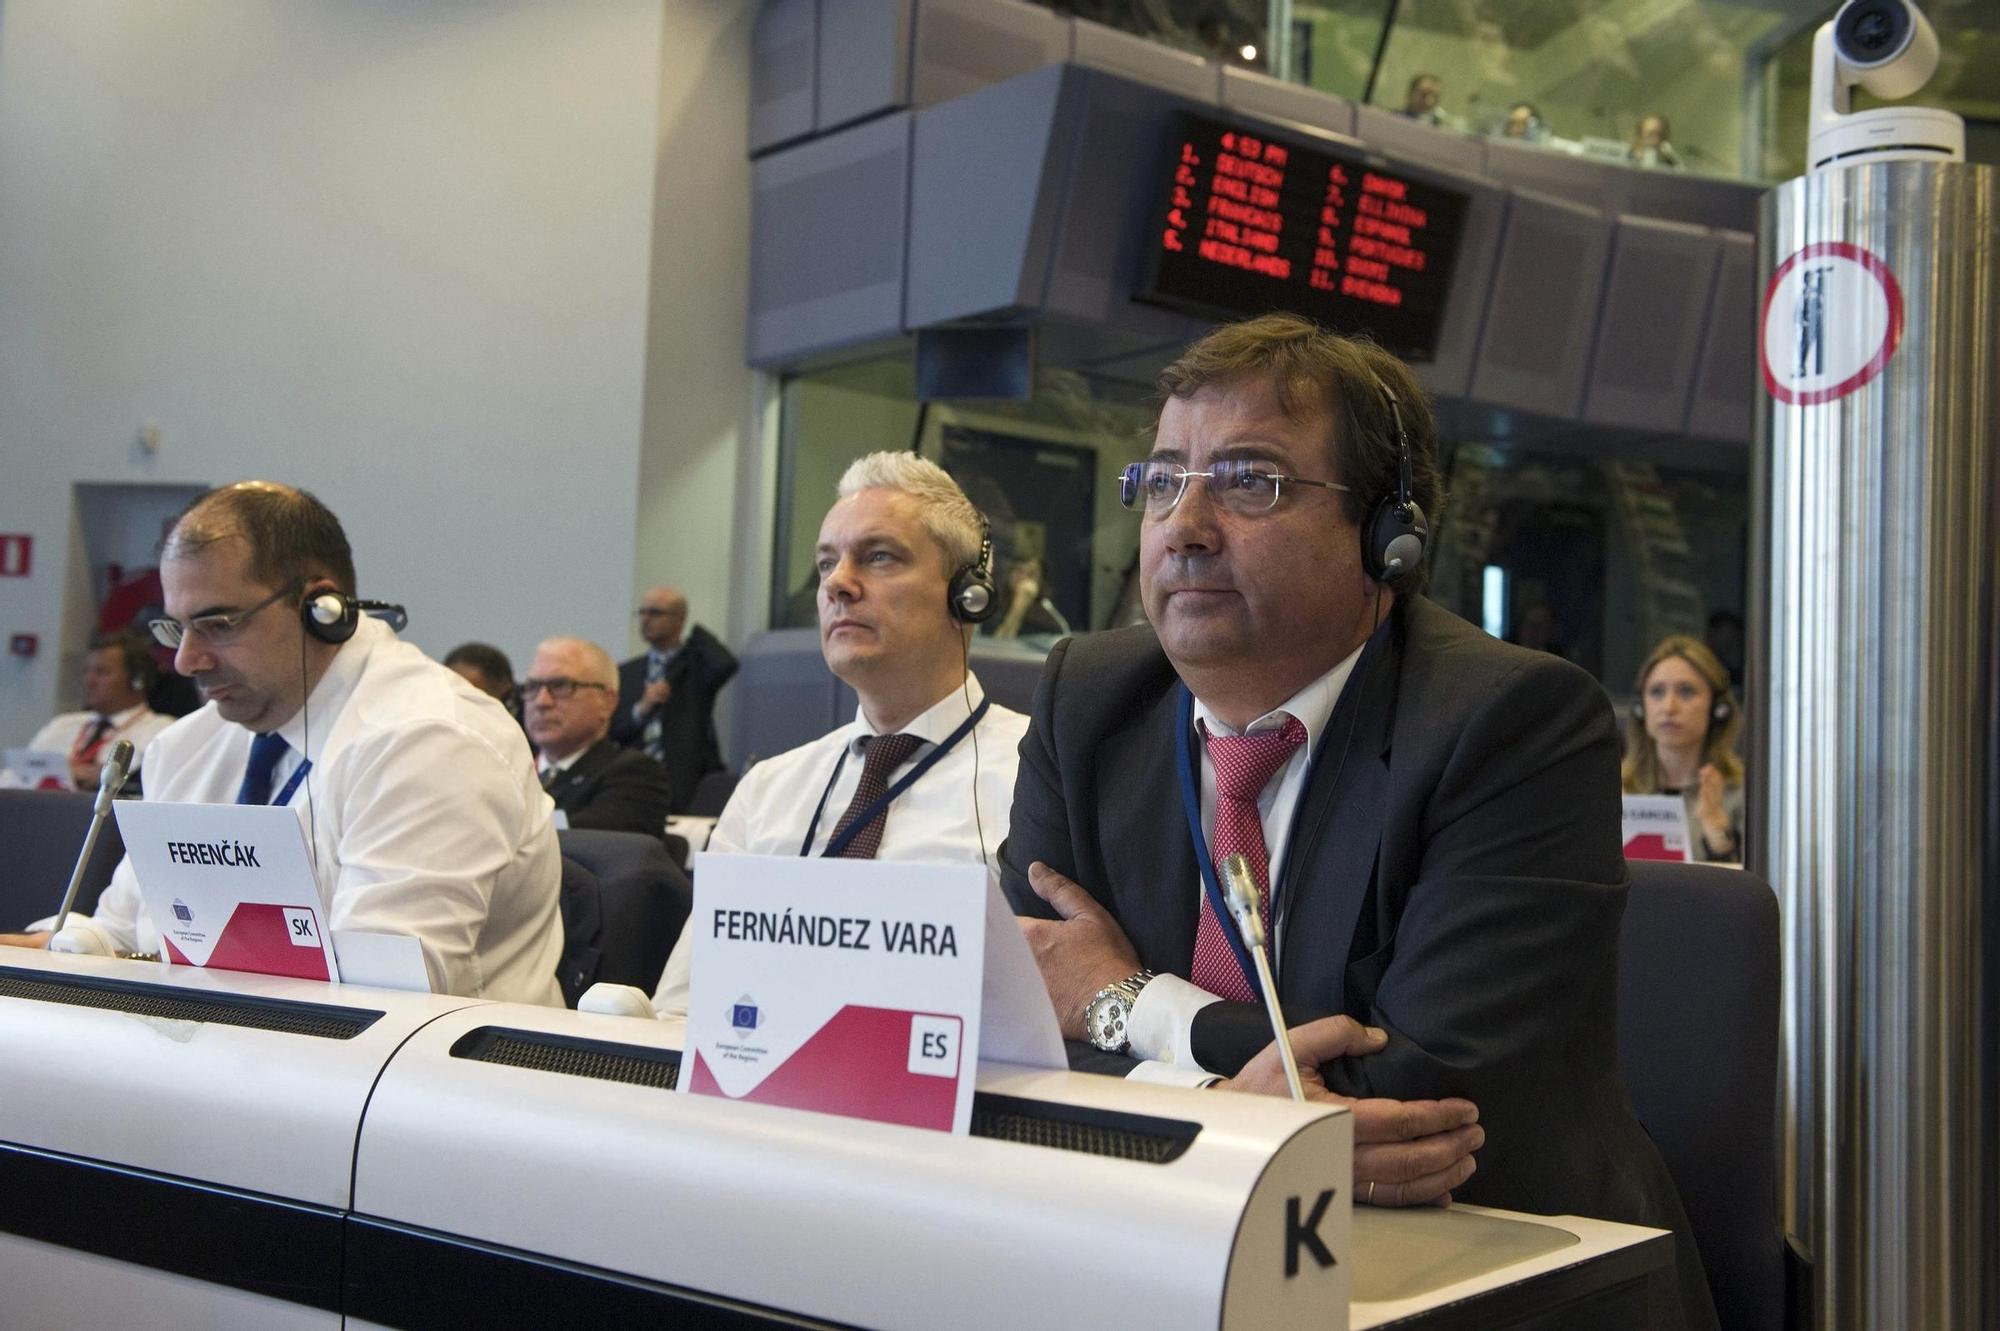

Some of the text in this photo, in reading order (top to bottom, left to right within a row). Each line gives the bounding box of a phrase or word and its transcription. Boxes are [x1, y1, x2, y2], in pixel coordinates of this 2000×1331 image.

[168, 840, 261, 868] FERENČÁK
[292, 918, 314, 937] SK
[713, 908, 958, 957] FERNÁNDEZ VARA
[921, 1033, 948, 1059] ES
[1285, 1189, 1337, 1279] K
